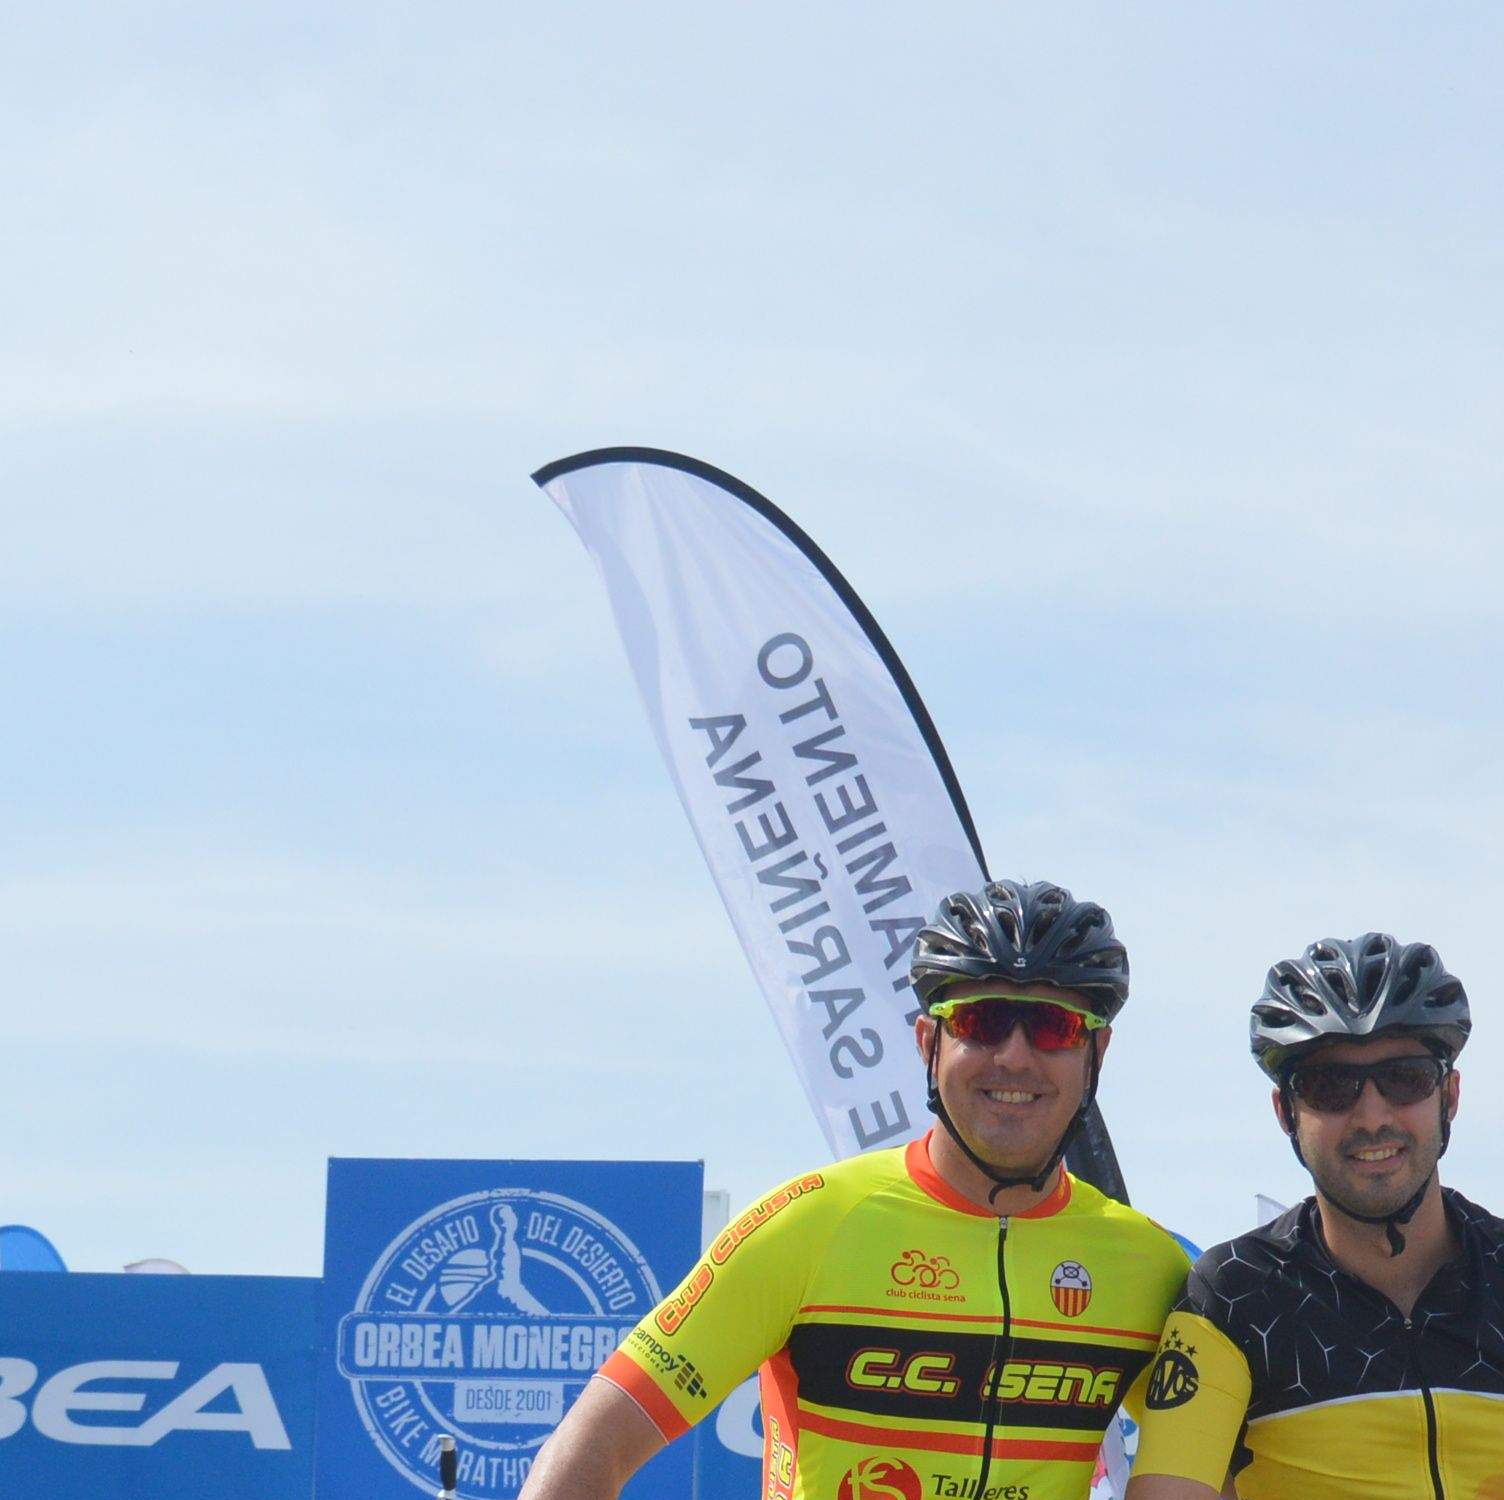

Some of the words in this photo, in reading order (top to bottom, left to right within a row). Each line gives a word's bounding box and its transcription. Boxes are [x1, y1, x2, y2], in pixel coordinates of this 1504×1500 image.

[386, 1285, 417, 1308] EL
[404, 1215, 481, 1282] DESAFIO
[527, 1211, 560, 1247] DEL
[562, 1226, 637, 1312] DESIERTO
[655, 1267, 713, 1336] CLUB
[711, 1173, 824, 1265] CICLISTA
[886, 1288, 907, 1298] club
[909, 1289, 943, 1301] ciclista
[945, 1293, 966, 1303] sena
[355, 1323, 463, 1369] ORBEA
[472, 1323, 634, 1371] MONEGR
[633, 1327, 679, 1372] campoy
[466, 1386, 511, 1412] DESDE
[516, 1387, 552, 1411] 2001
[847, 1349, 960, 1395] C.C.
[986, 1361, 1123, 1407] SENA
[377, 1385, 428, 1447] BIKE
[419, 1434, 532, 1488] MRATHO
